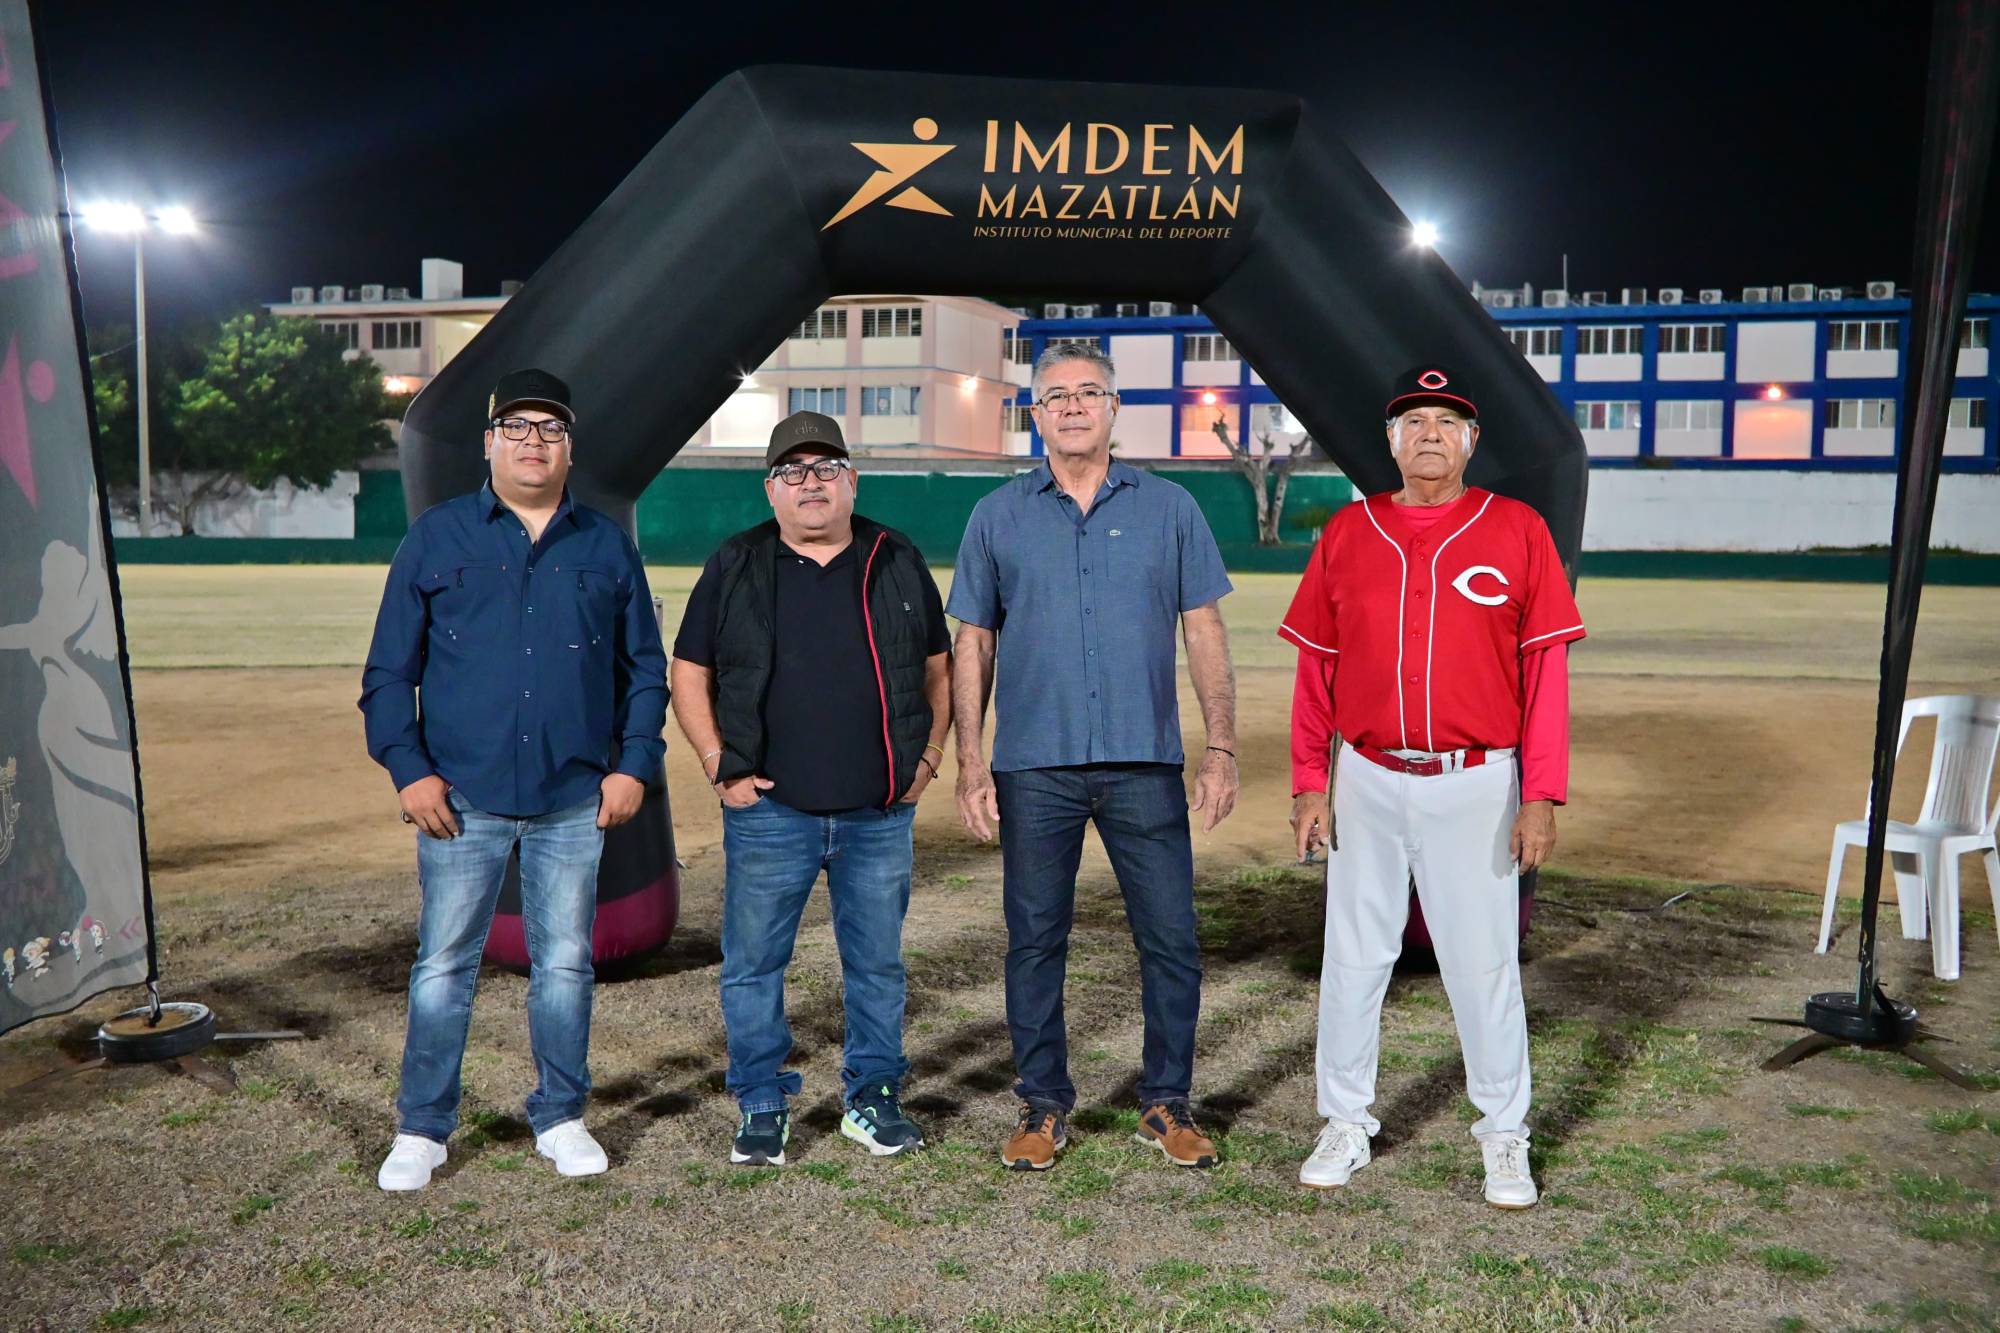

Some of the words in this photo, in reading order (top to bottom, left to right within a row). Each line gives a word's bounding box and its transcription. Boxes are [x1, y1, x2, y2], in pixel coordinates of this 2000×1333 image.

[984, 119, 1244, 175] IMDEM
[977, 176, 1242, 220] MAZATLÁN
[973, 226, 1052, 238] INSTITUTO
[1056, 227, 1133, 239] MUNICIPAL
[1138, 227, 1164, 239] DEL
[1168, 227, 1233, 239] DEPORTE
[1451, 565, 1510, 606] C
